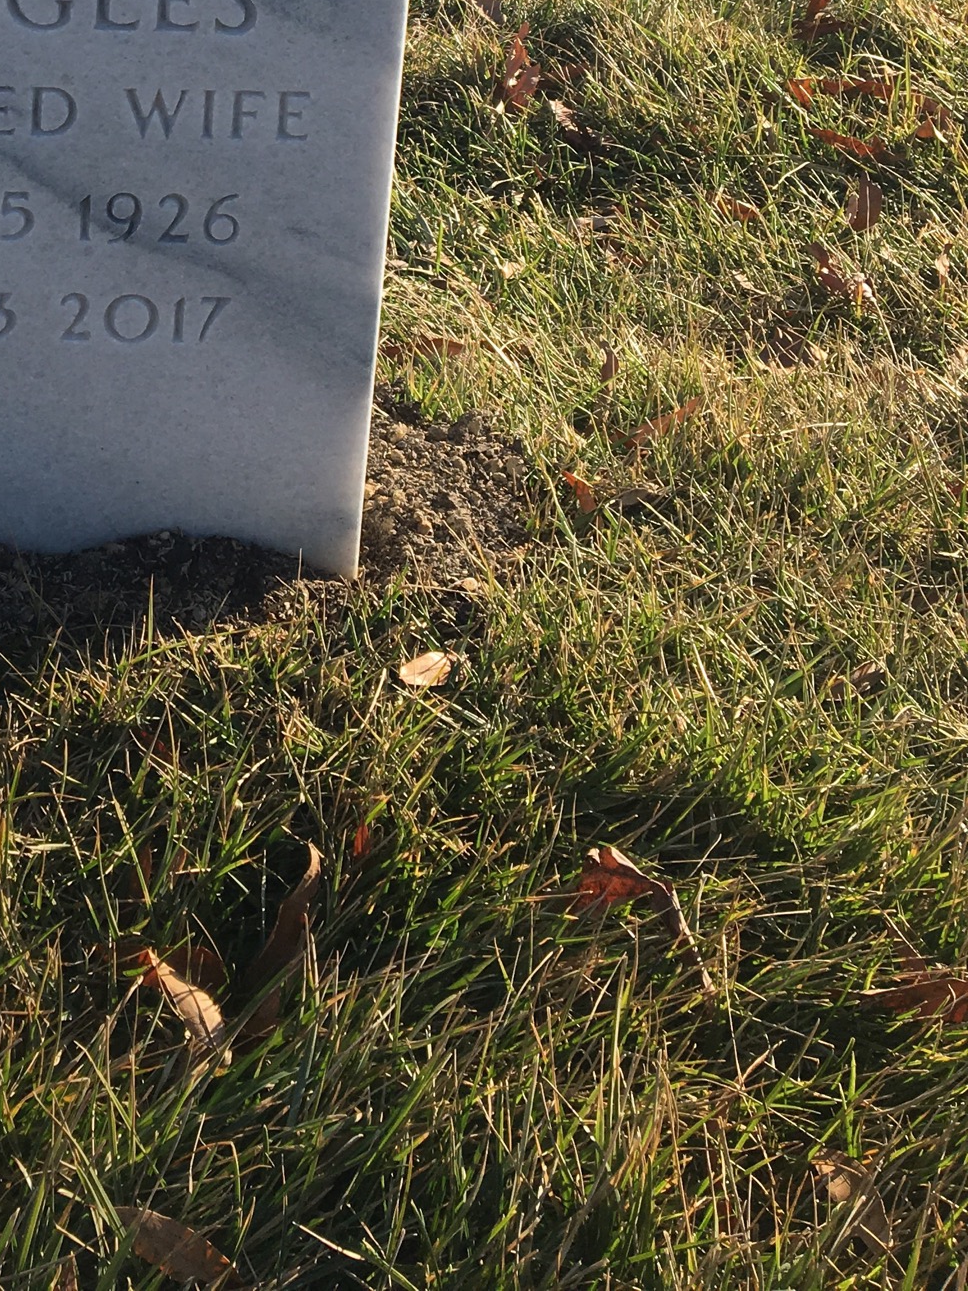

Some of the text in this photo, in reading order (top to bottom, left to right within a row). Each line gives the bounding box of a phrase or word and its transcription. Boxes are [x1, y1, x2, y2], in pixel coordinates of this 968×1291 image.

[124, 87, 312, 142] WIFE
[77, 191, 241, 245] 1926
[59, 293, 233, 344] 2017
